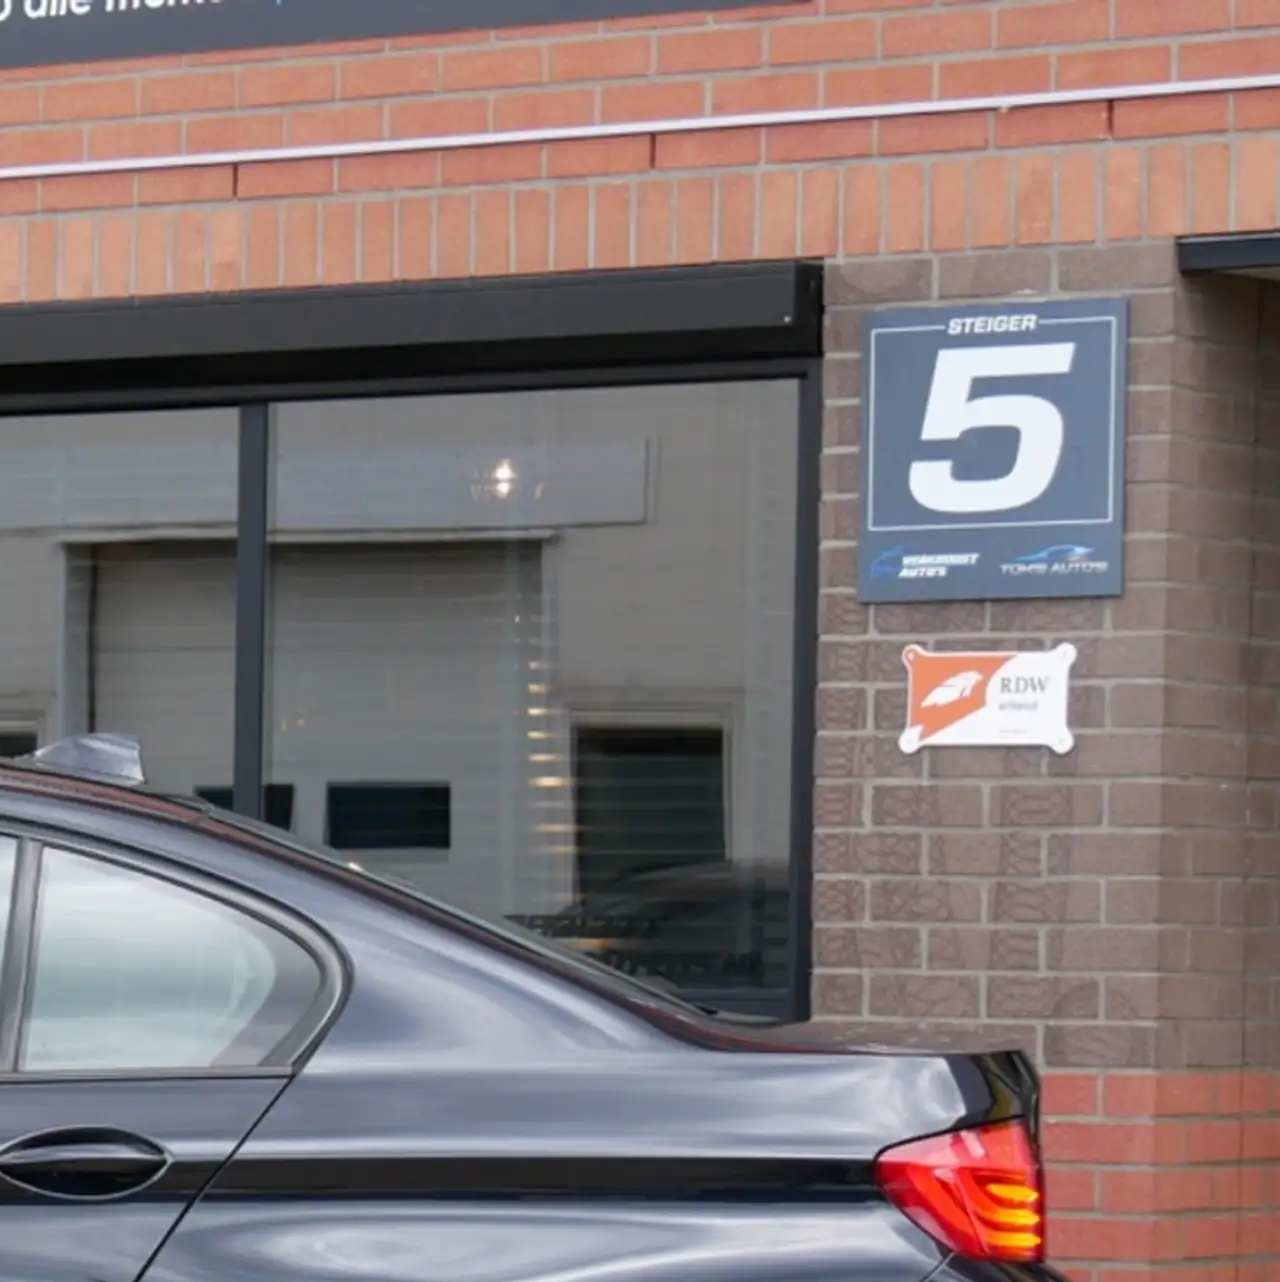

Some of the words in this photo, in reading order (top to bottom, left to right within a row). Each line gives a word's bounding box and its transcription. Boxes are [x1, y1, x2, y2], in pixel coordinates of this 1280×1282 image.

[947, 314, 1038, 335] STEIGER
[908, 342, 1077, 513] 5
[1000, 676, 1051, 693] RDW
